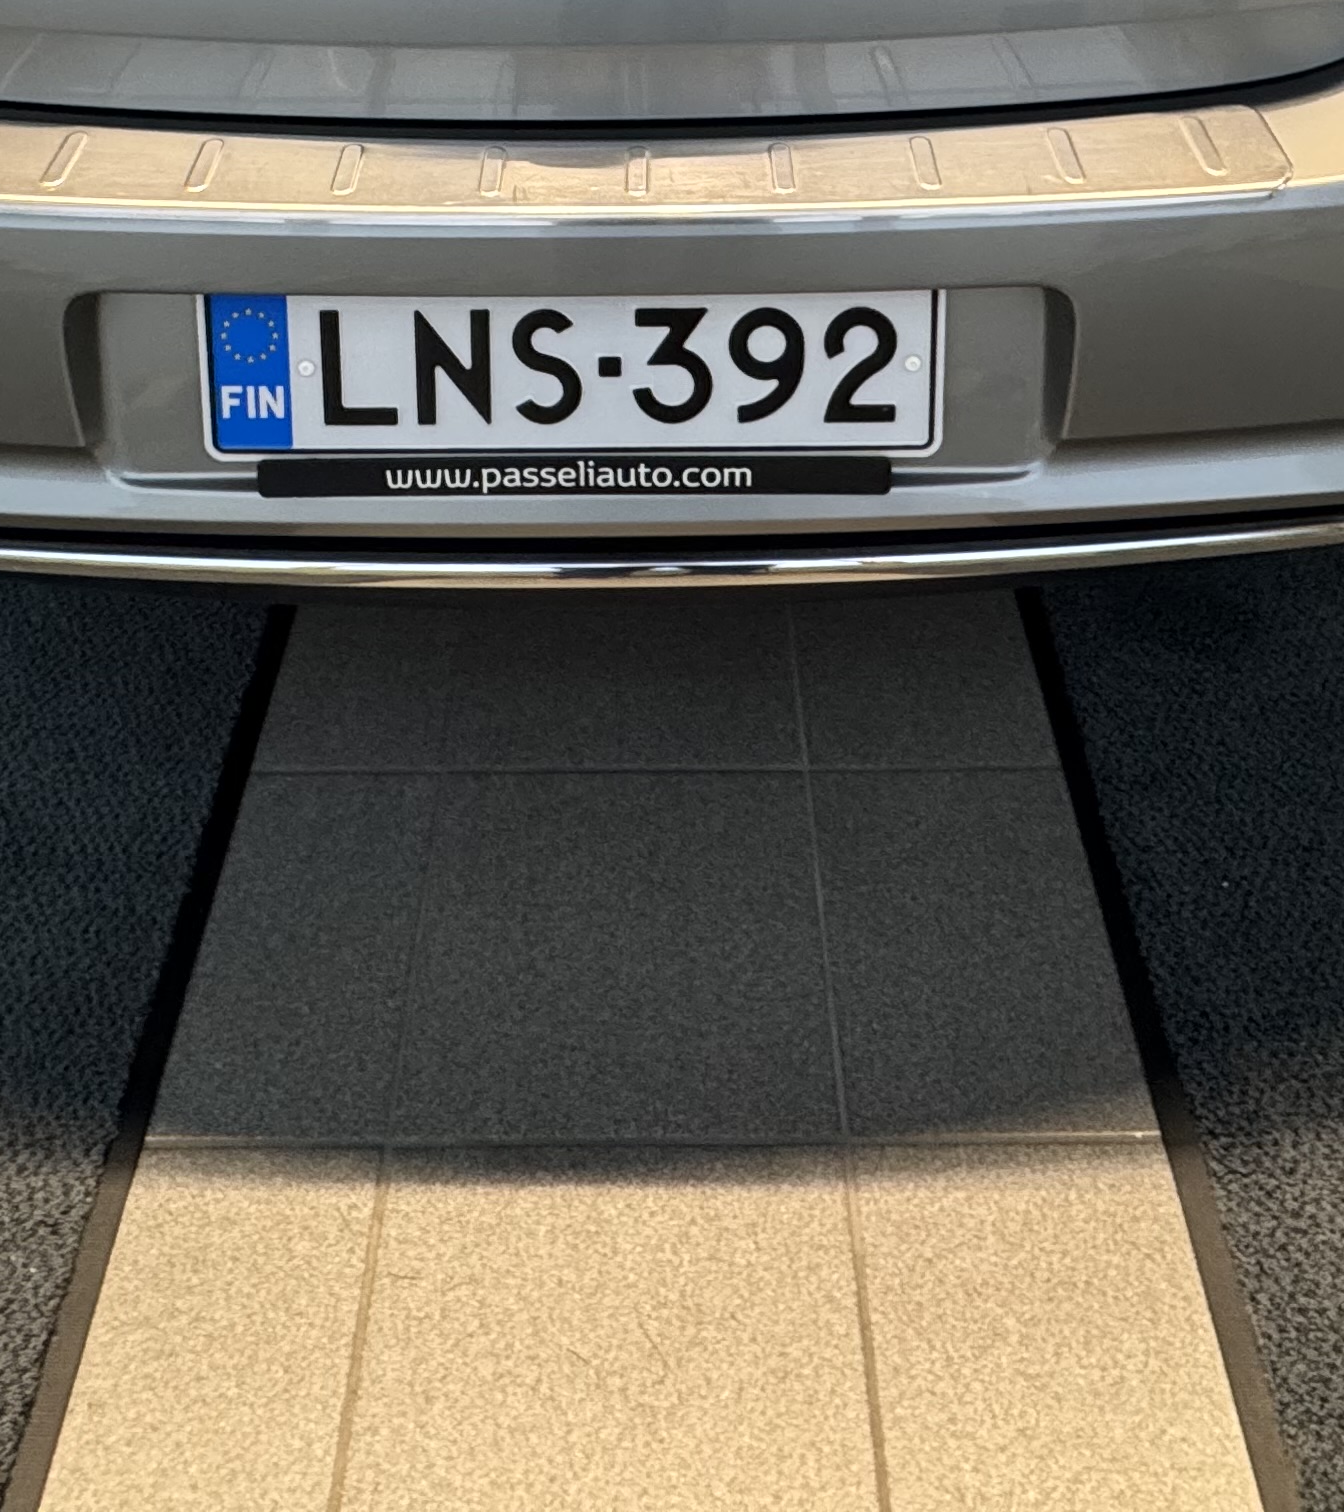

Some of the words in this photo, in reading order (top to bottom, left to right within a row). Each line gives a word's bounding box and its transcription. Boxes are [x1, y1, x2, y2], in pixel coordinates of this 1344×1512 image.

[220, 385, 286, 419] FIN
[318, 306, 899, 427] LNS-392
[384, 460, 754, 494] www.passeliauto.com
